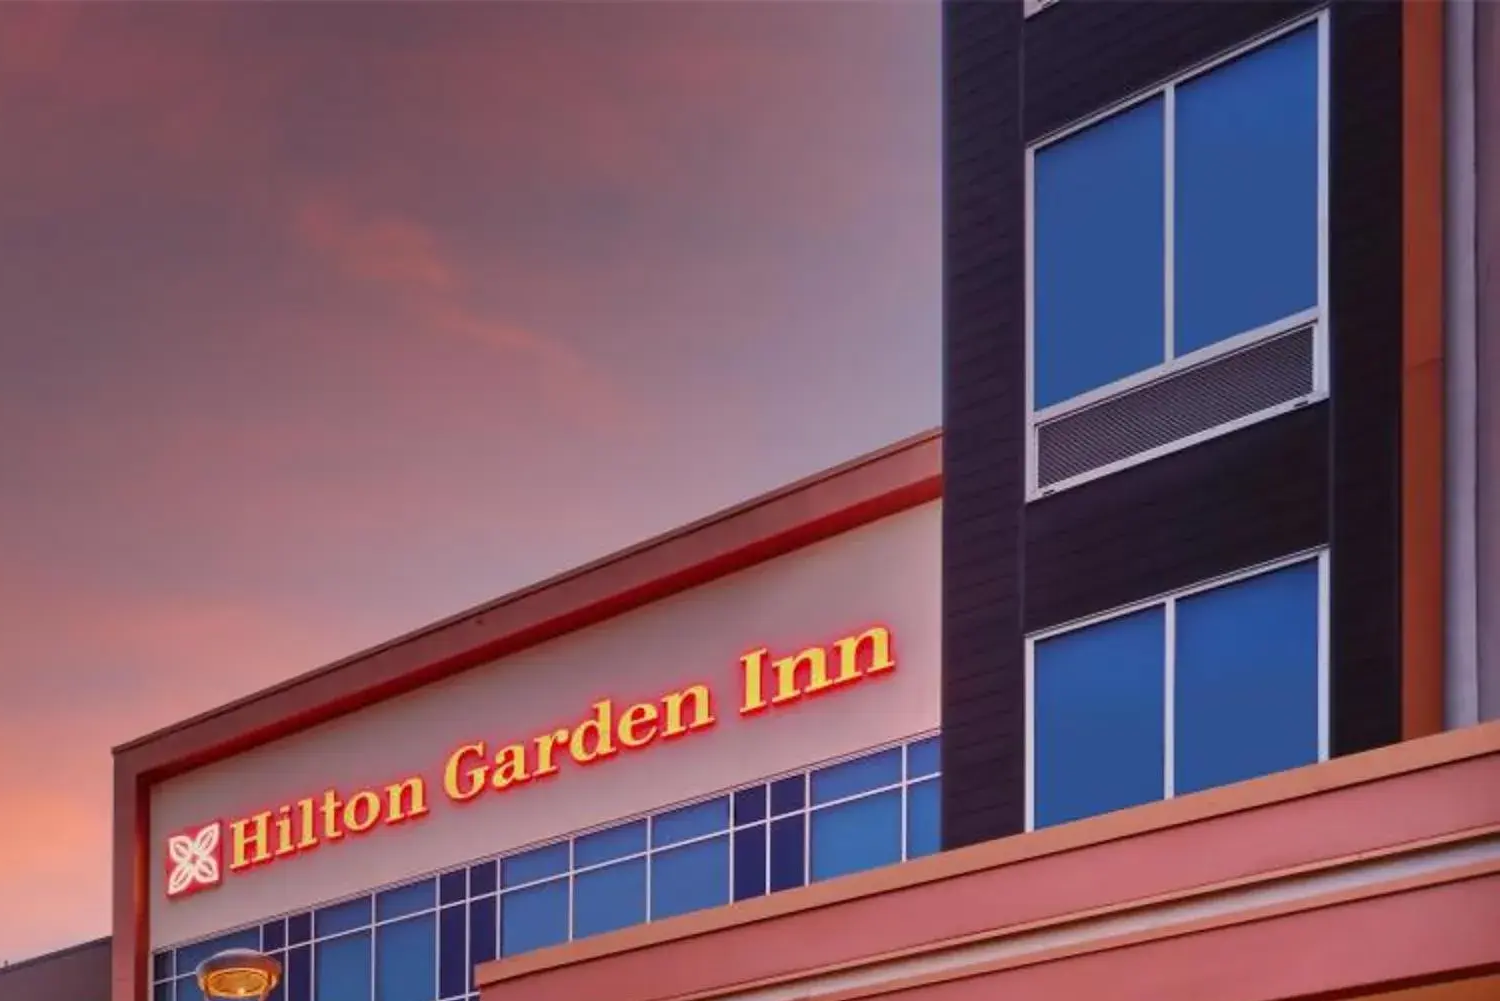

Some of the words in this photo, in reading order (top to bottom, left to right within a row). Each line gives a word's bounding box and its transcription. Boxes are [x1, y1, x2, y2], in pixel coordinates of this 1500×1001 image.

[229, 775, 430, 870] Hilton
[443, 682, 716, 801] Garden
[739, 624, 896, 714] Inn
